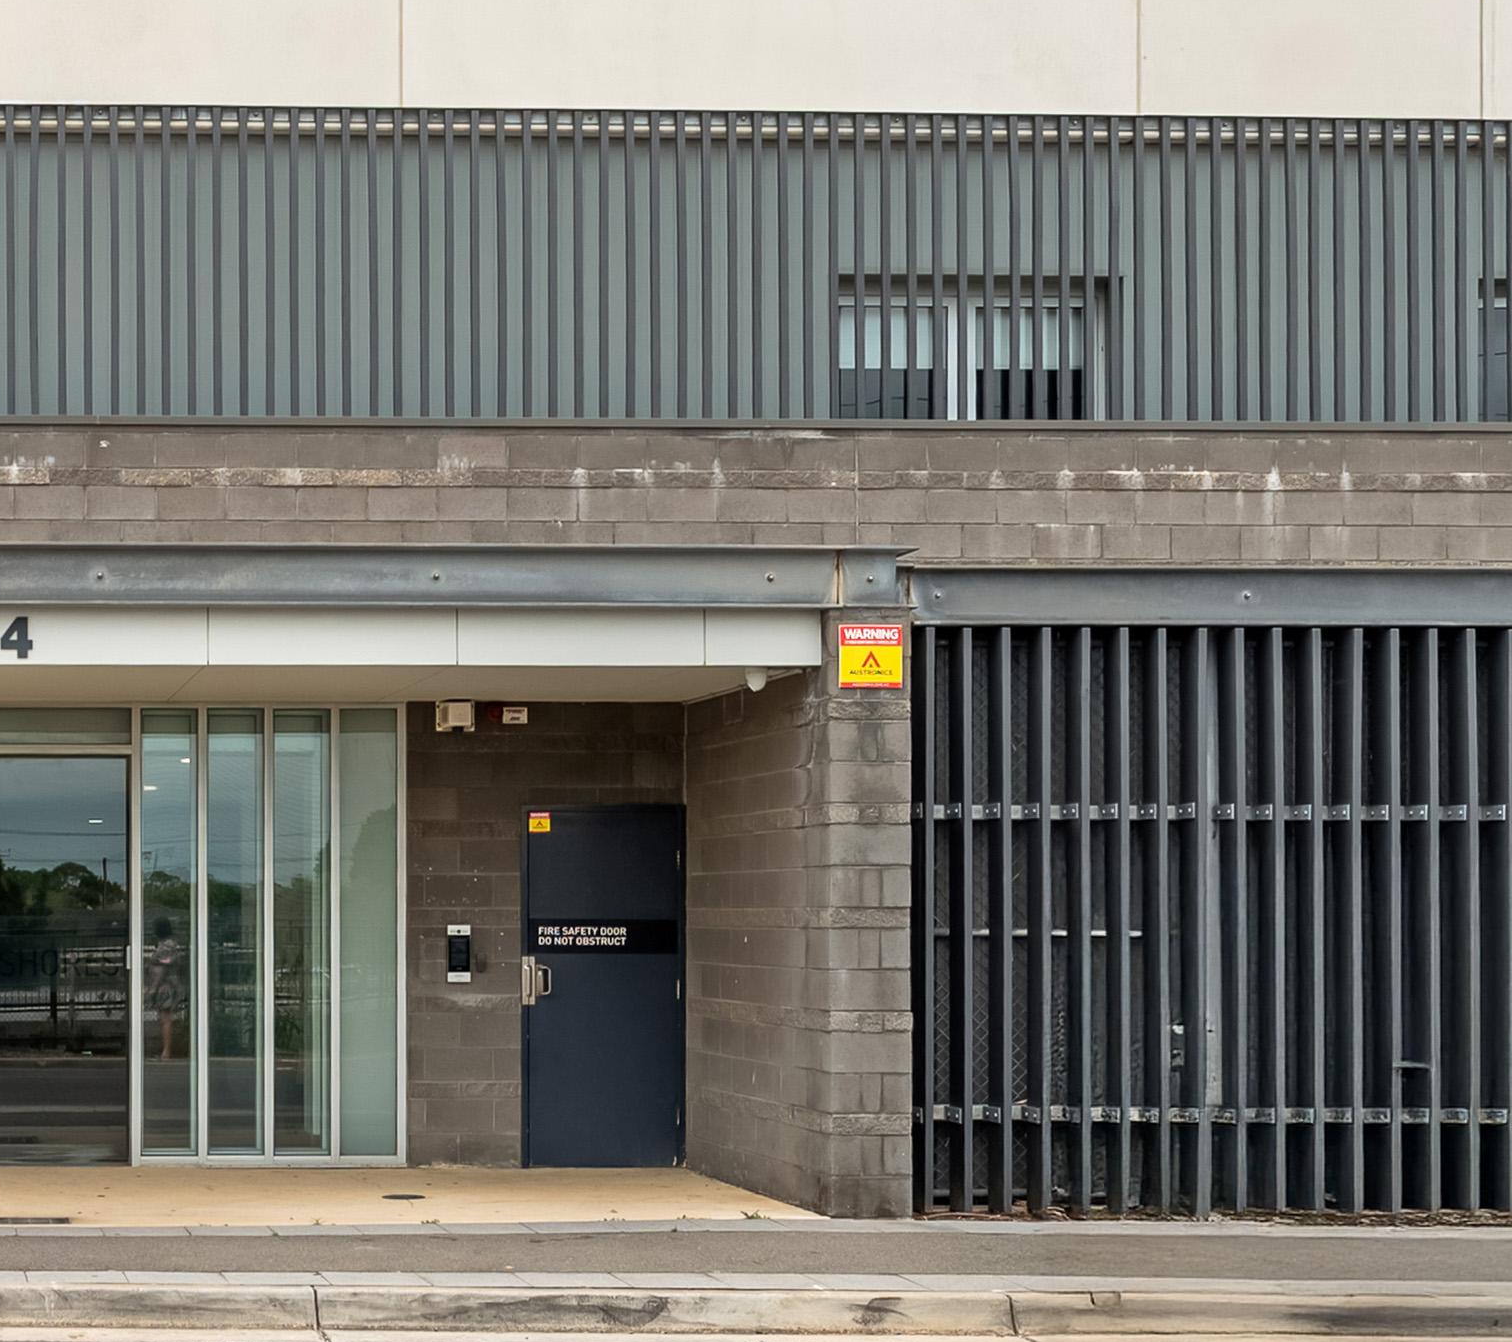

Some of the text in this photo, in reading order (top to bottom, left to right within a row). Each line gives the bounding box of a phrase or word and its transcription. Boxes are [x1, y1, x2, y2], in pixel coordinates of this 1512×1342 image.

[844, 628, 899, 640] WARNING
[538, 926, 627, 936] FIRE SAFETY DOOR
[538, 936, 627, 946] DO NOT OBSTRUCT
